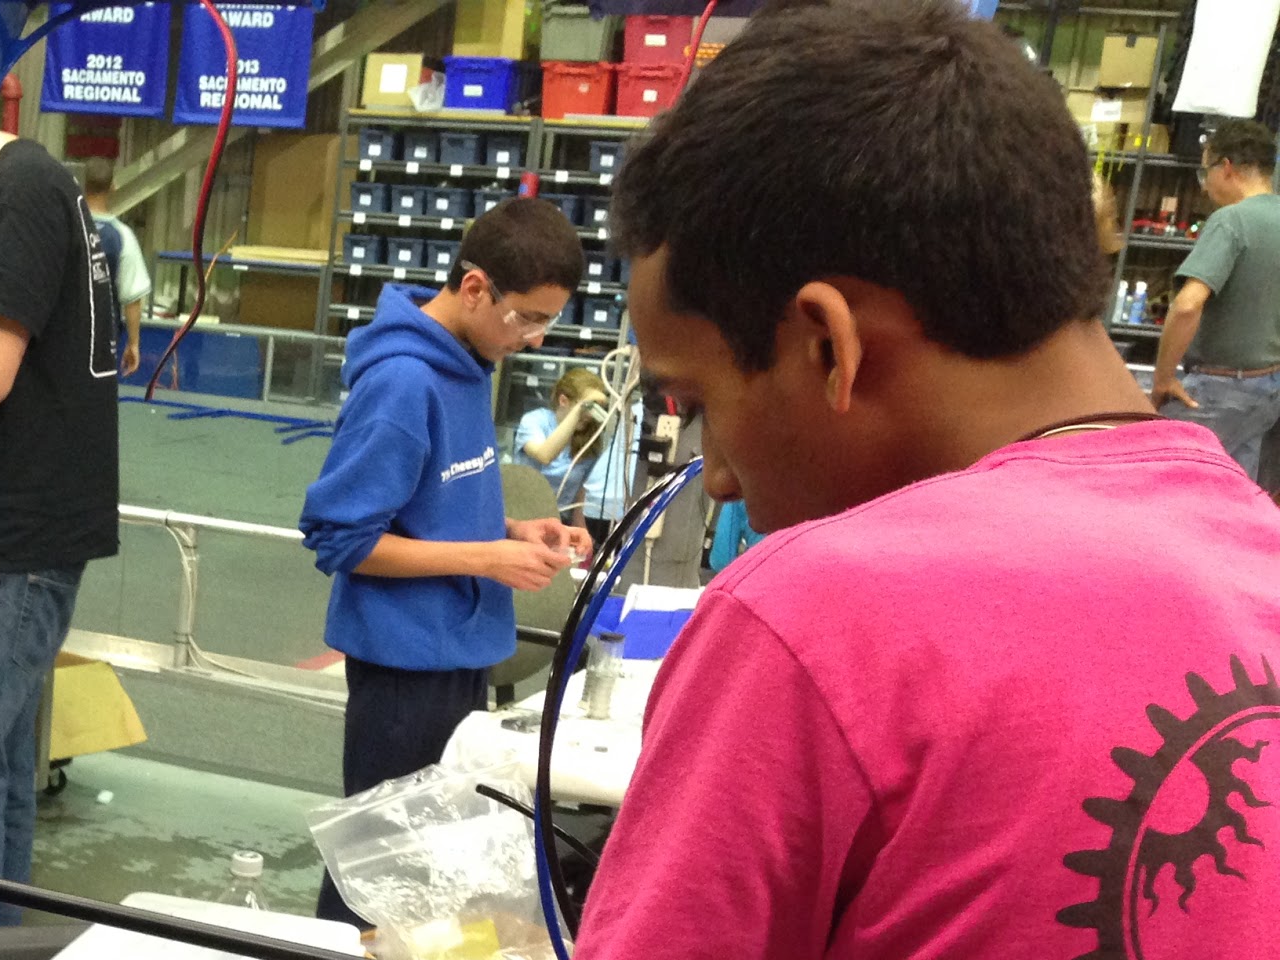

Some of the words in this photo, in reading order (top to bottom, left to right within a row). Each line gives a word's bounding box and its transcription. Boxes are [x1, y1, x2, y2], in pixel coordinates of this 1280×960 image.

[86, 54, 122, 69] 2012
[61, 69, 146, 86] SACRAMENTO
[63, 84, 142, 103] REGIONAL
